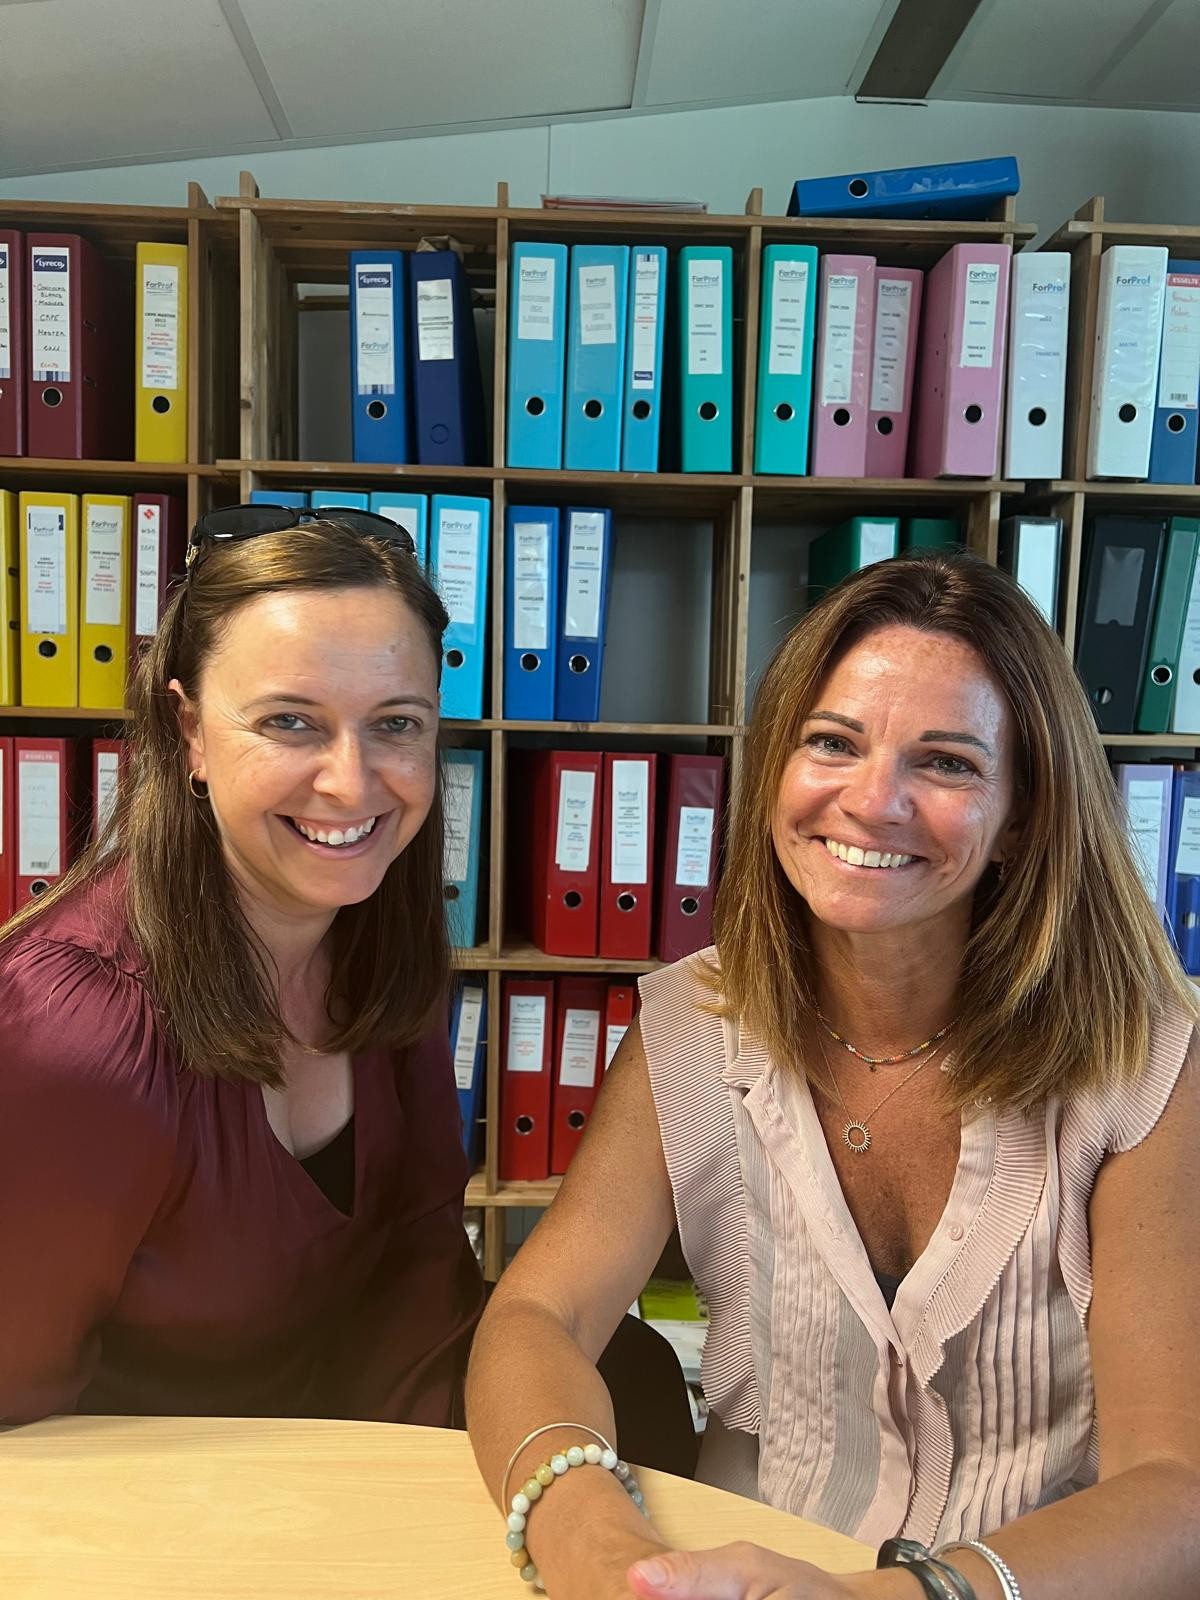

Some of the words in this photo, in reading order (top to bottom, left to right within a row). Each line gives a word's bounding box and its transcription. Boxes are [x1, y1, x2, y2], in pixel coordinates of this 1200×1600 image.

[522, 269, 548, 277] ForProf
[779, 270, 807, 278] ForProf
[969, 271, 998, 279] ForProf
[830, 277, 857, 285] ForProf
[1116, 276, 1151, 285] ForProf
[146, 281, 174, 289] ForProf
[881, 285, 909, 293] ForProf
[1033, 283, 1067, 292] ForProf
[361, 343, 389, 351] ForProf
[443, 521, 472, 529] ForProf
